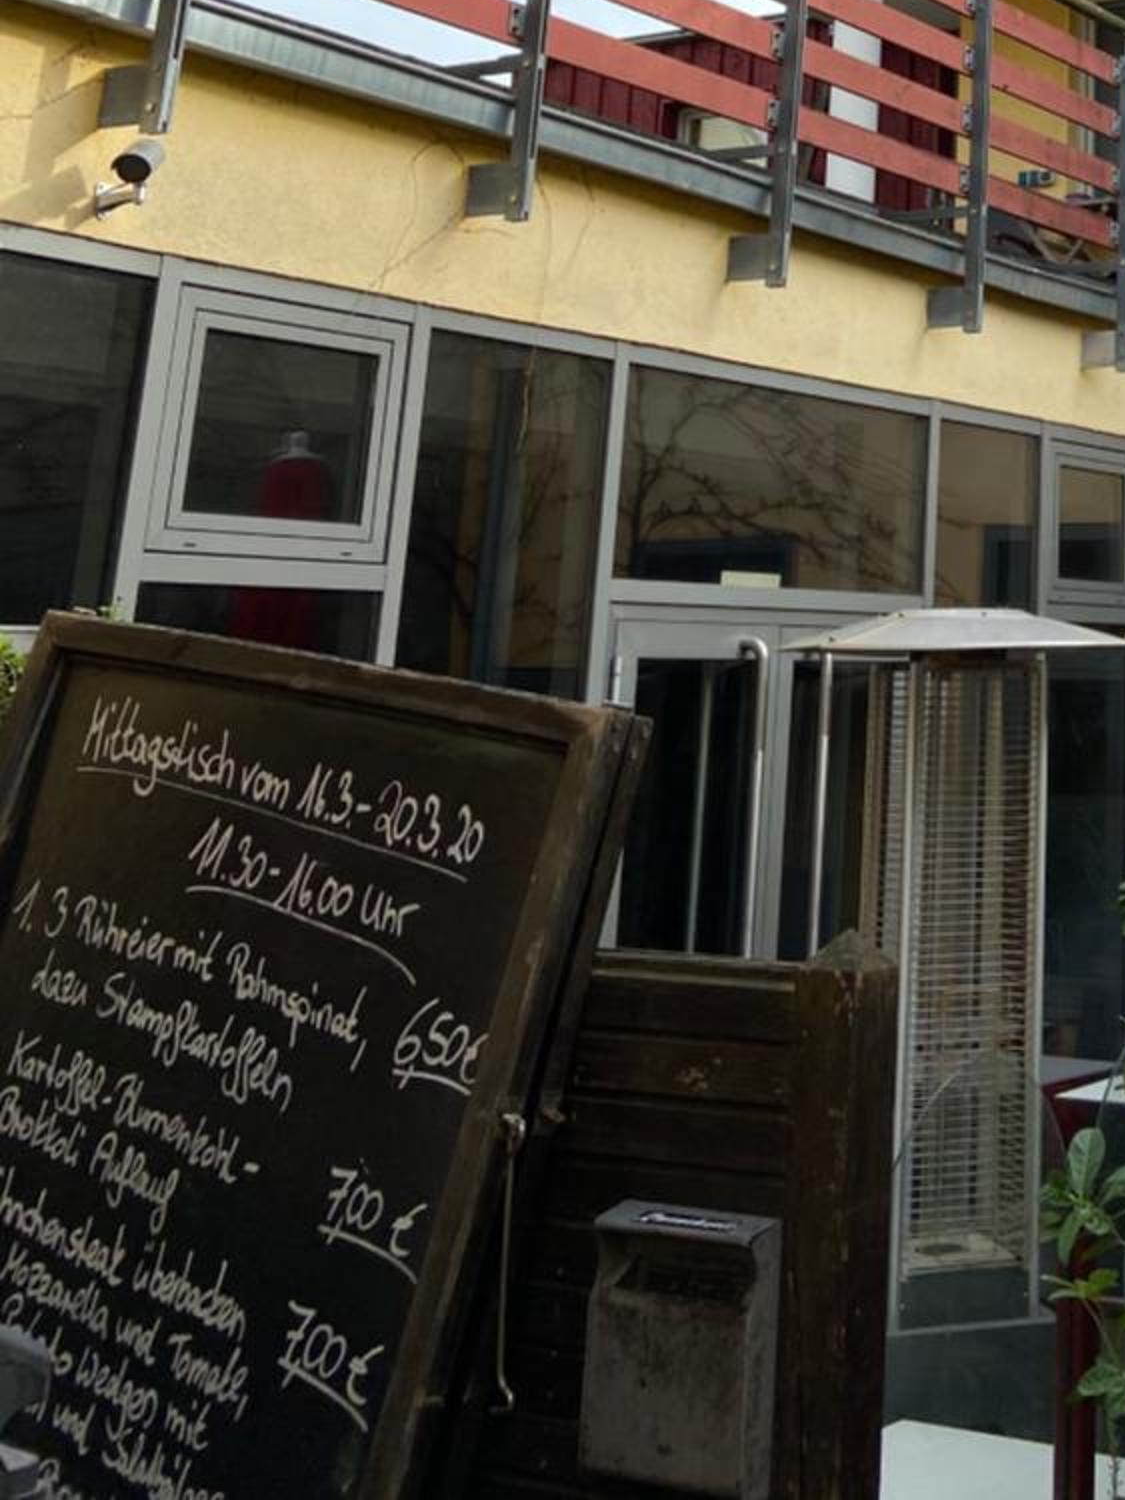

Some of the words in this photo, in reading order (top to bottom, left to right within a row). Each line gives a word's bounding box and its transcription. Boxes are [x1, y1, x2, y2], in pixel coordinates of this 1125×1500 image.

[82, 696, 235, 796] Mittagstisch
[239, 762, 291, 809] vom
[12, 879, 41, 933] 1.
[44, 885, 69, 938] 3
[172, 930, 223, 982] mit
[361, 884, 421, 937] Uhr
[31, 948, 88, 1006] dazu
[116, 1316, 162, 1366] und
[164, 1399, 212, 1451] mit
